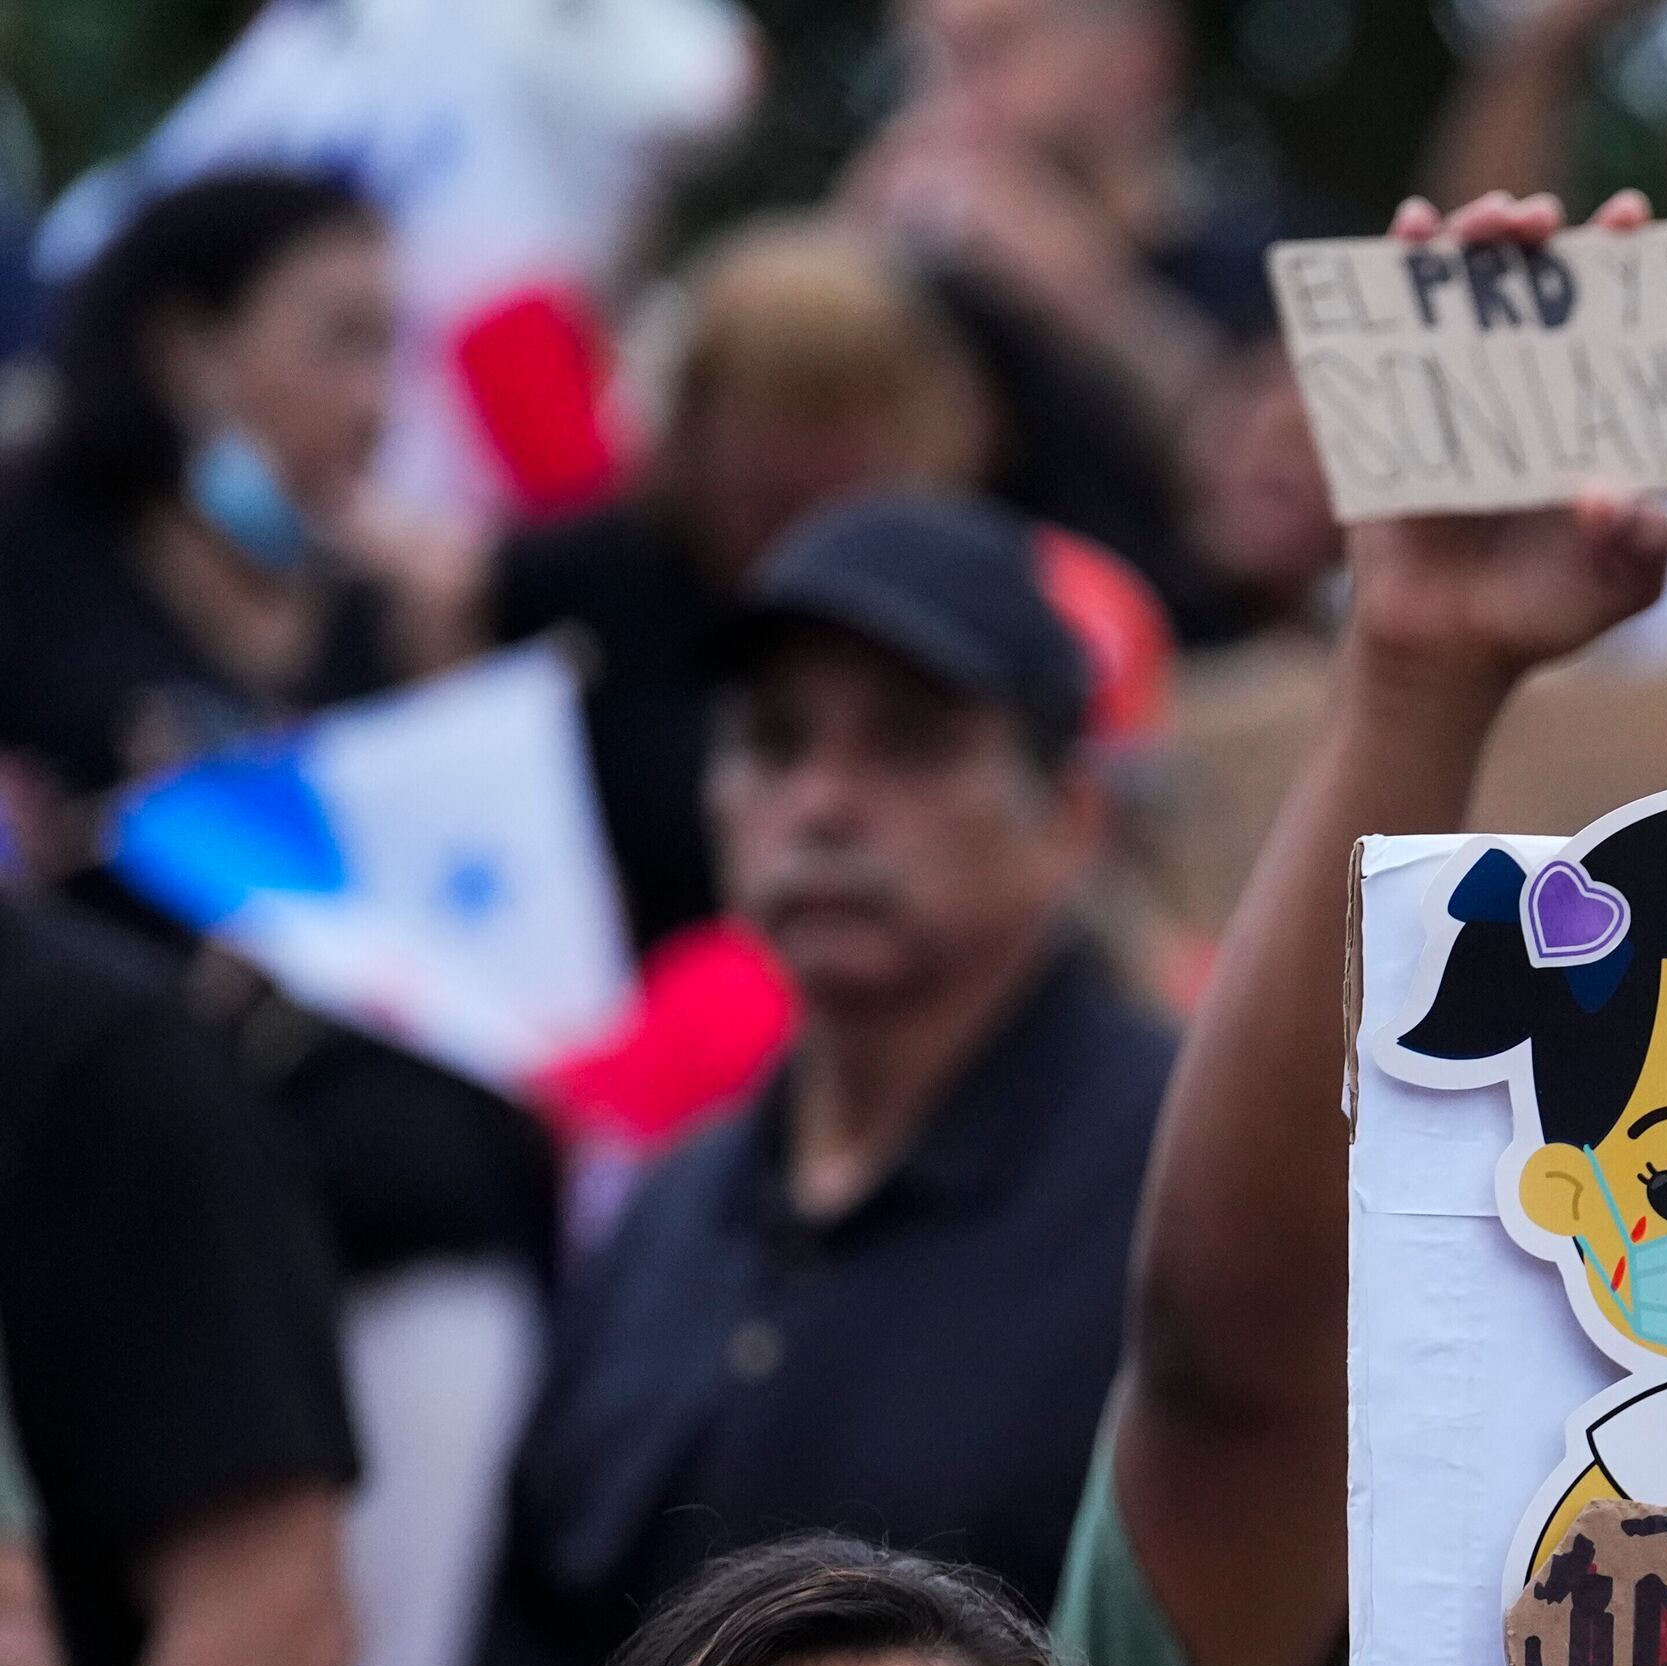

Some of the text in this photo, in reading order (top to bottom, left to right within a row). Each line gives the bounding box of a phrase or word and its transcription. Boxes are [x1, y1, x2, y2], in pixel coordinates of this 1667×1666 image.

[1287, 250, 1398, 336] EL
[1406, 243, 1577, 333] PRD
[1600, 245, 1641, 327] Y
[1302, 346, 1532, 492] SON
